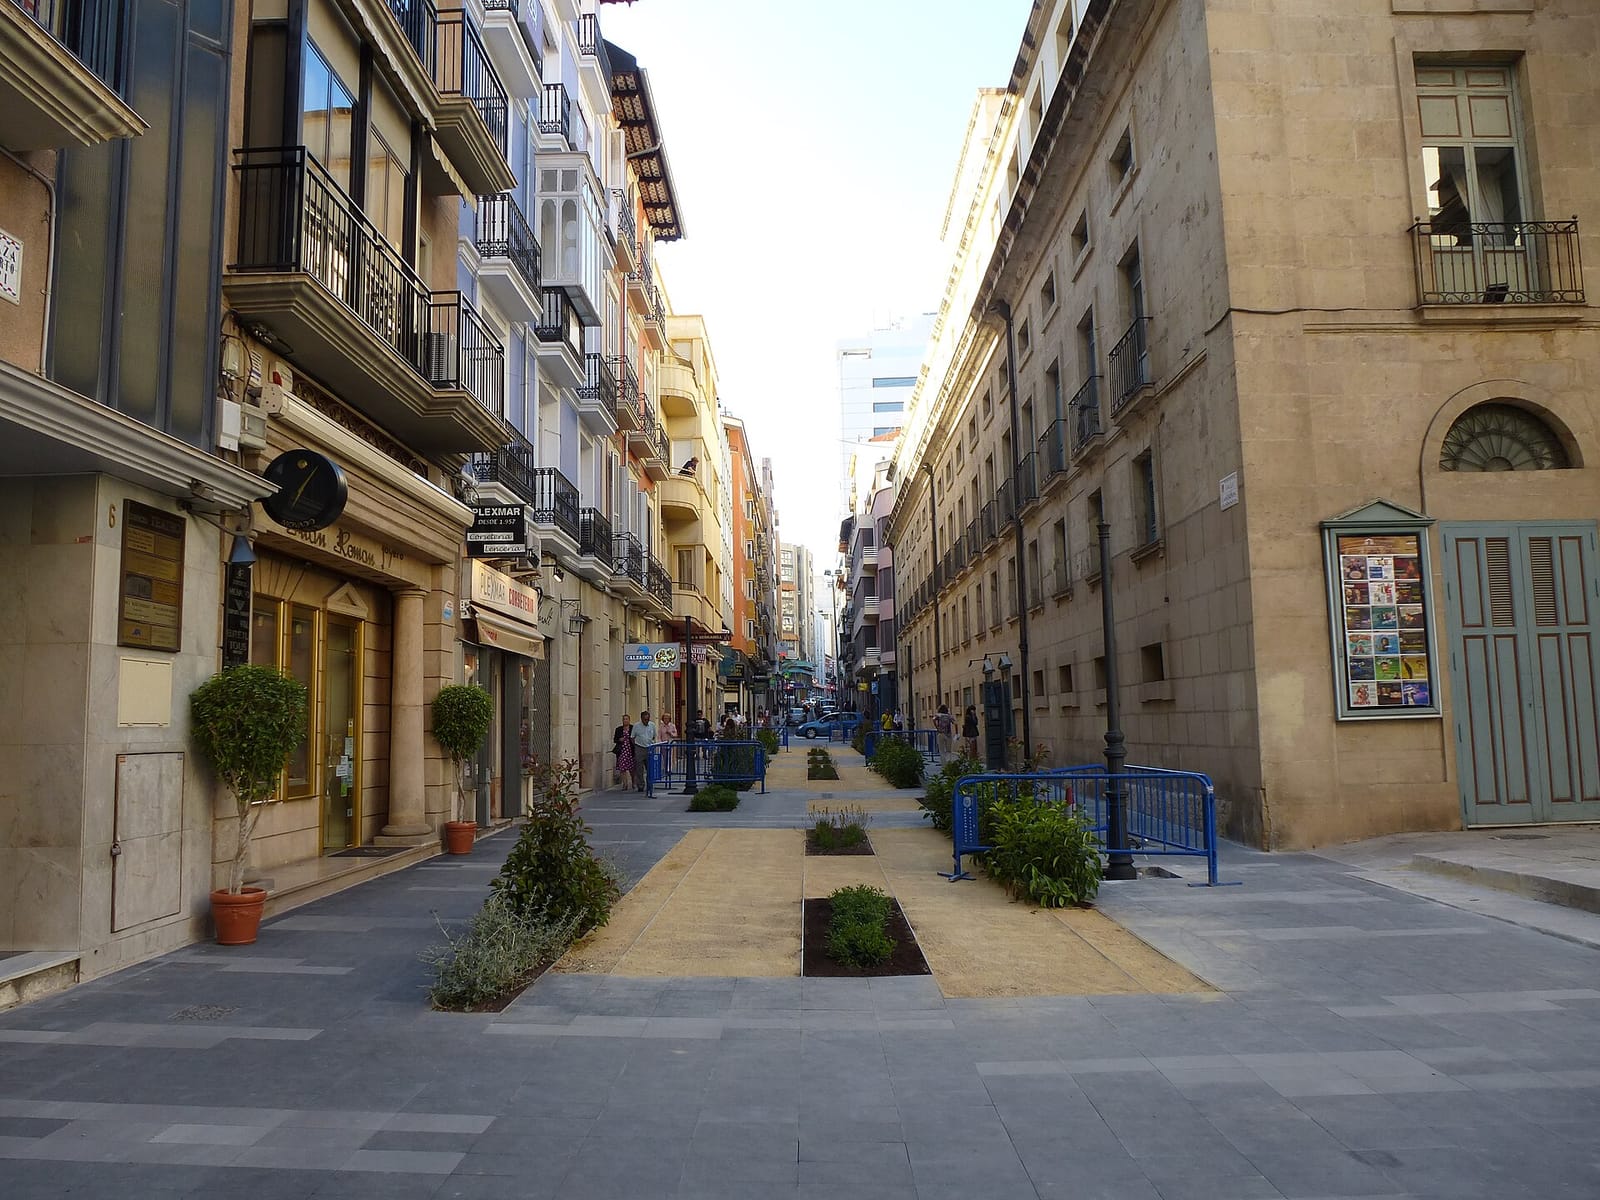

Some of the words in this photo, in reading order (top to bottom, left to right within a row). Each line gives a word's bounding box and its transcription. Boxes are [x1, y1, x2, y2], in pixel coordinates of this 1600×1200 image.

[109, 503, 116, 529] 6
[472, 507, 521, 516] PLEXMAR
[480, 572, 505, 601] PLEXMAR
